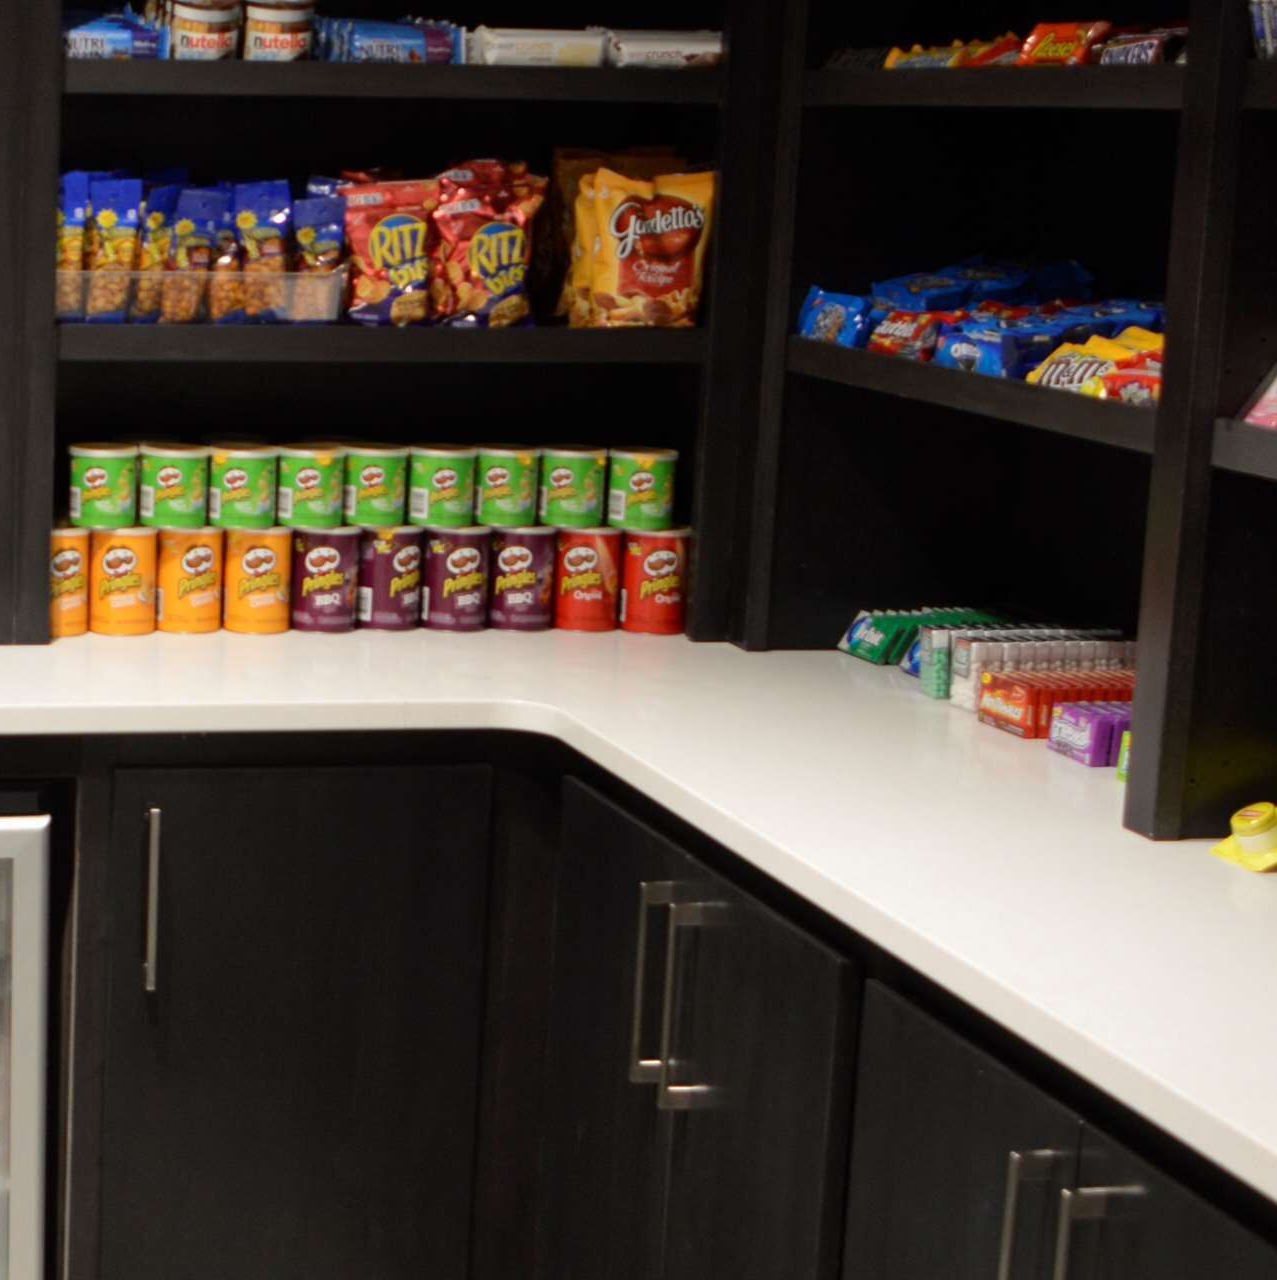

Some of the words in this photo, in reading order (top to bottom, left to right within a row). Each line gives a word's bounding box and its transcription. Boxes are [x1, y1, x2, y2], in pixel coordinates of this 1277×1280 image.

[180, 32, 232, 49] nutella
[254, 33, 306, 49] nutella
[374, 222, 428, 269] RITZ
[474, 228, 524, 275] RITZ
[457, 592, 482, 607] BBQ
[507, 592, 534, 606] BBQ
